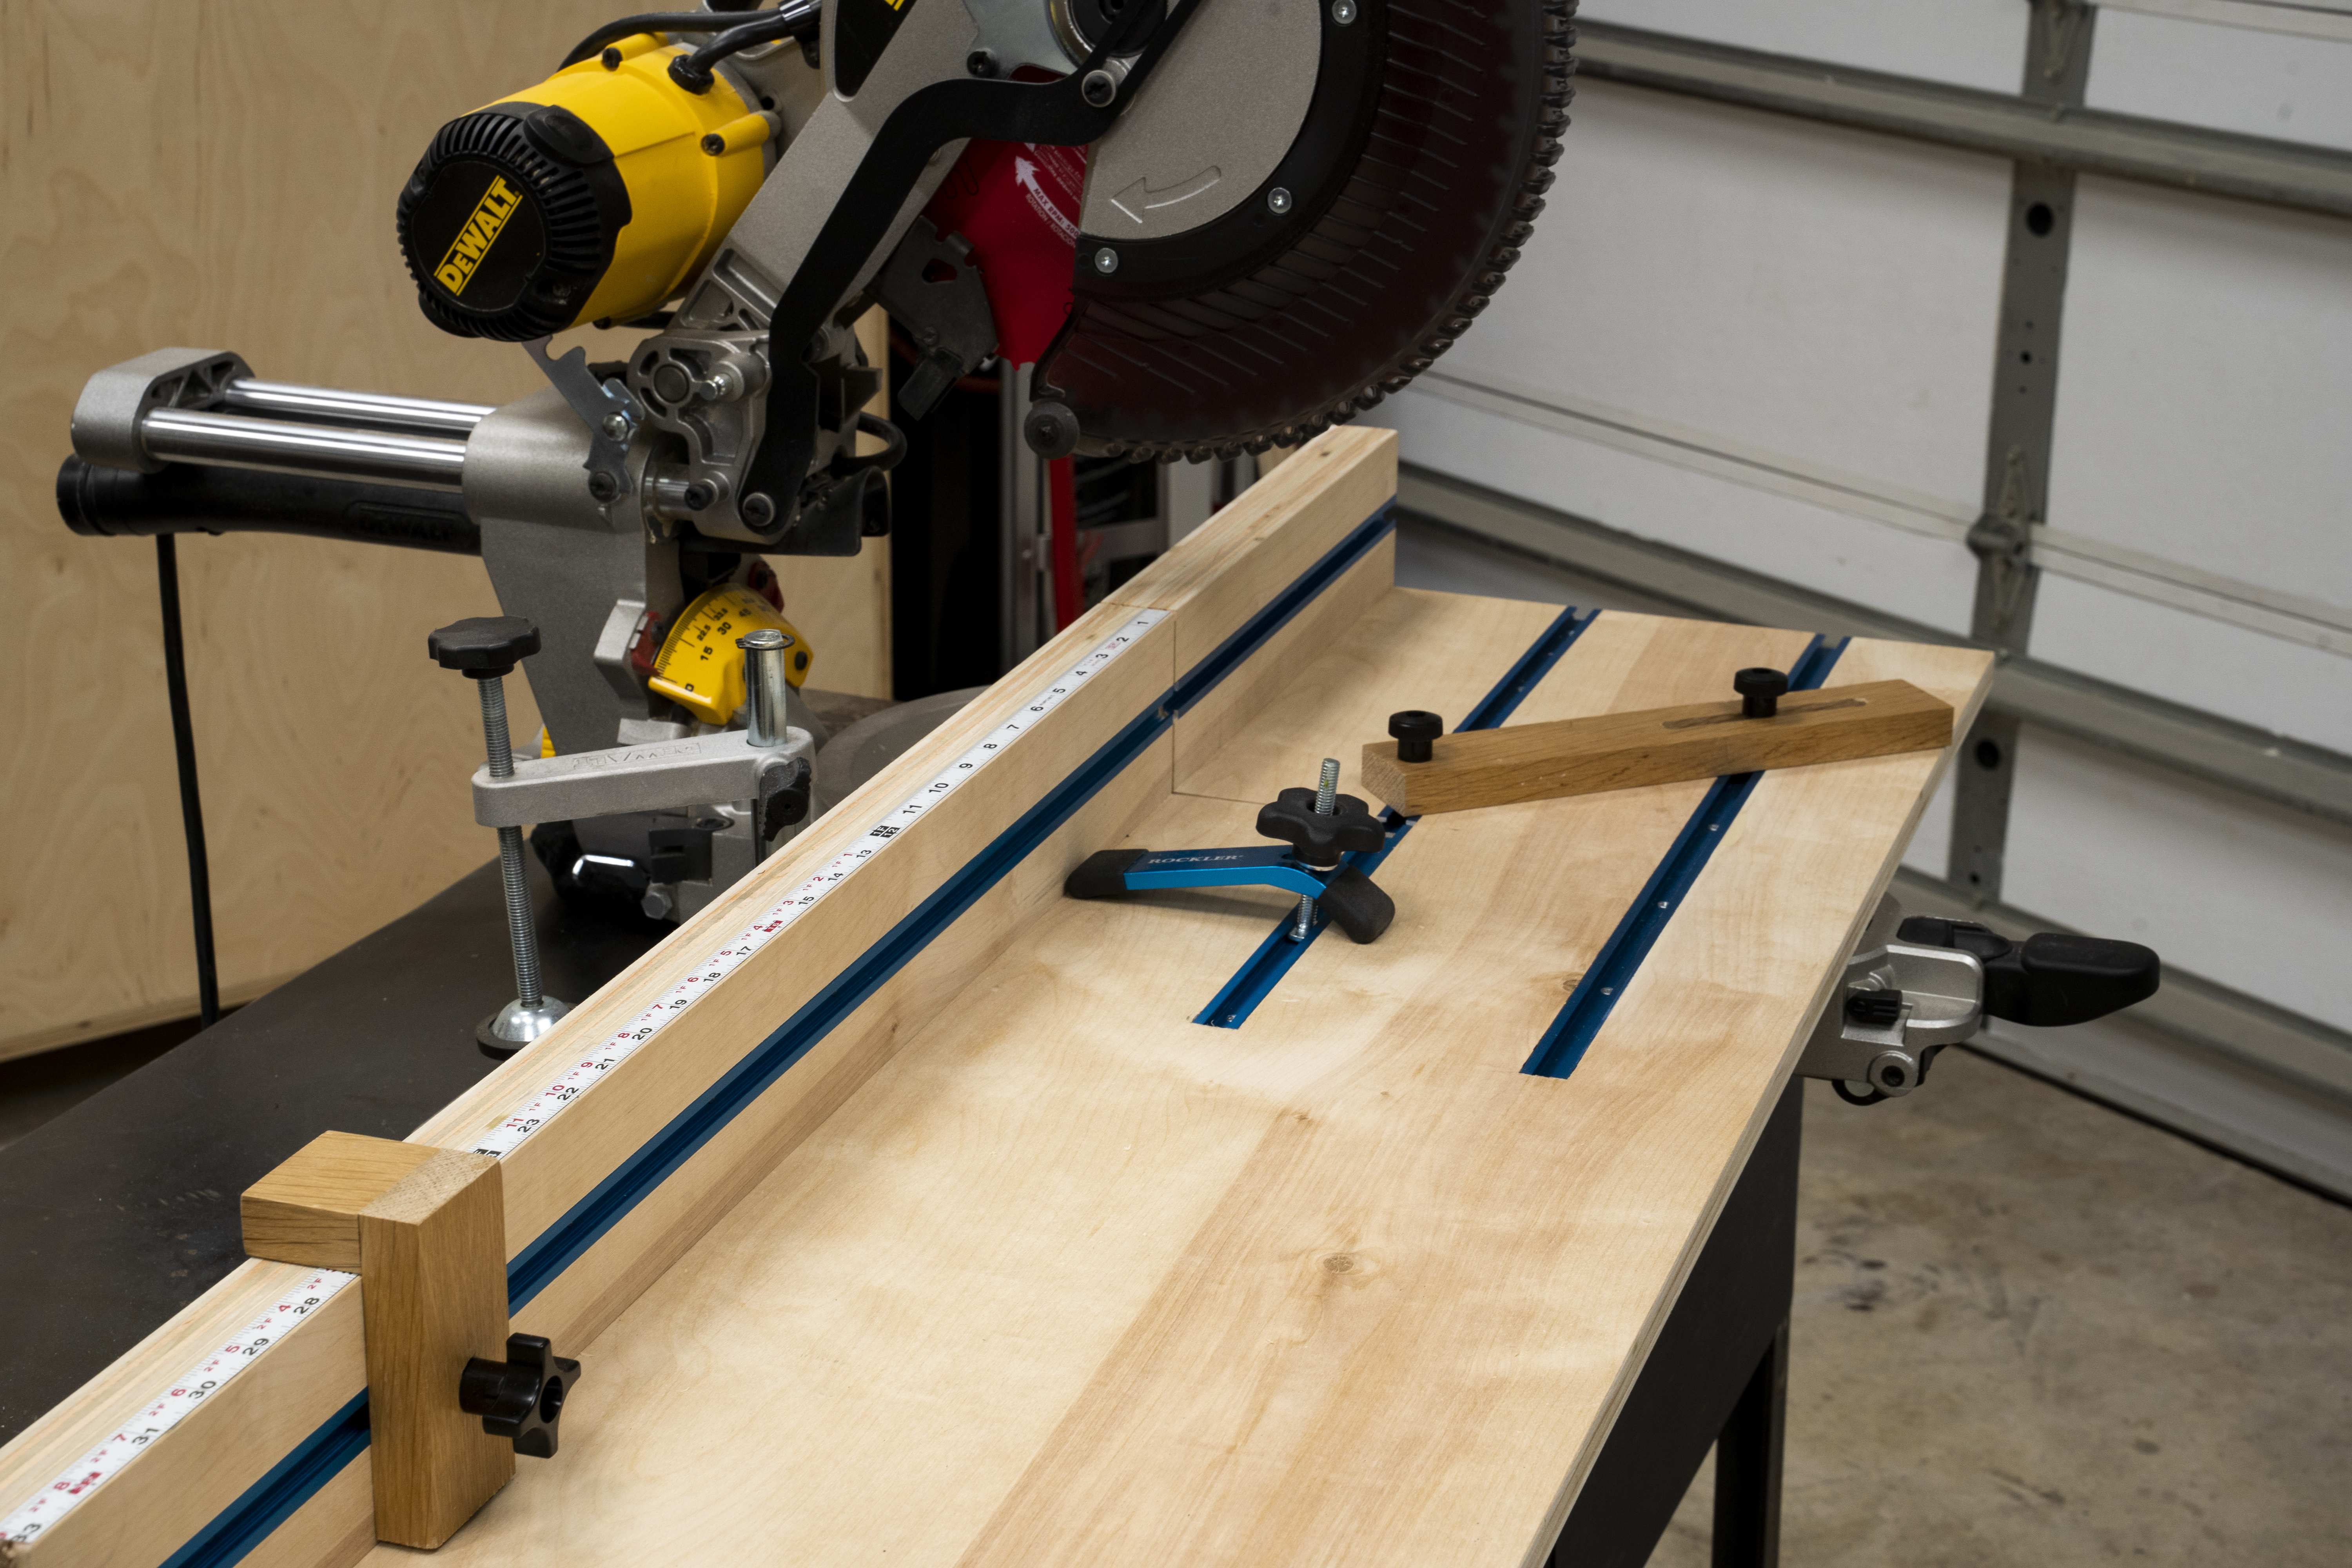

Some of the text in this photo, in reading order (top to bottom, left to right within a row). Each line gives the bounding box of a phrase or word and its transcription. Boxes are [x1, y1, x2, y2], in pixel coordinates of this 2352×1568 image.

[1034, 188, 1049, 206] MAX
[437, 178, 517, 294] DEWALT
[717, 622, 732, 635] 30
[700, 646, 713, 661] 15
[929, 783, 949, 793] 10
[902, 805, 923, 814] 11
[828, 873, 844, 881] 14
[798, 896, 814, 905] 15
[736, 946, 751, 955] 17
[703, 973, 721, 982] 18
[669, 999, 687, 1009] 19
[632, 1028, 652, 1040] 20
[595, 1058, 615, 1070] 21
[545, 1085, 564, 1096] 10
[557, 1087, 579, 1101] 22
[506, 1118, 524, 1128] 11
[517, 1119, 540, 1132] 23
[293, 1297, 320, 1314] 28
[242, 1338, 270, 1356] 29
[188, 1381, 217, 1399] 30
[132, 1428, 160, 1445] 31
[53, 1482, 71, 1490] 8
